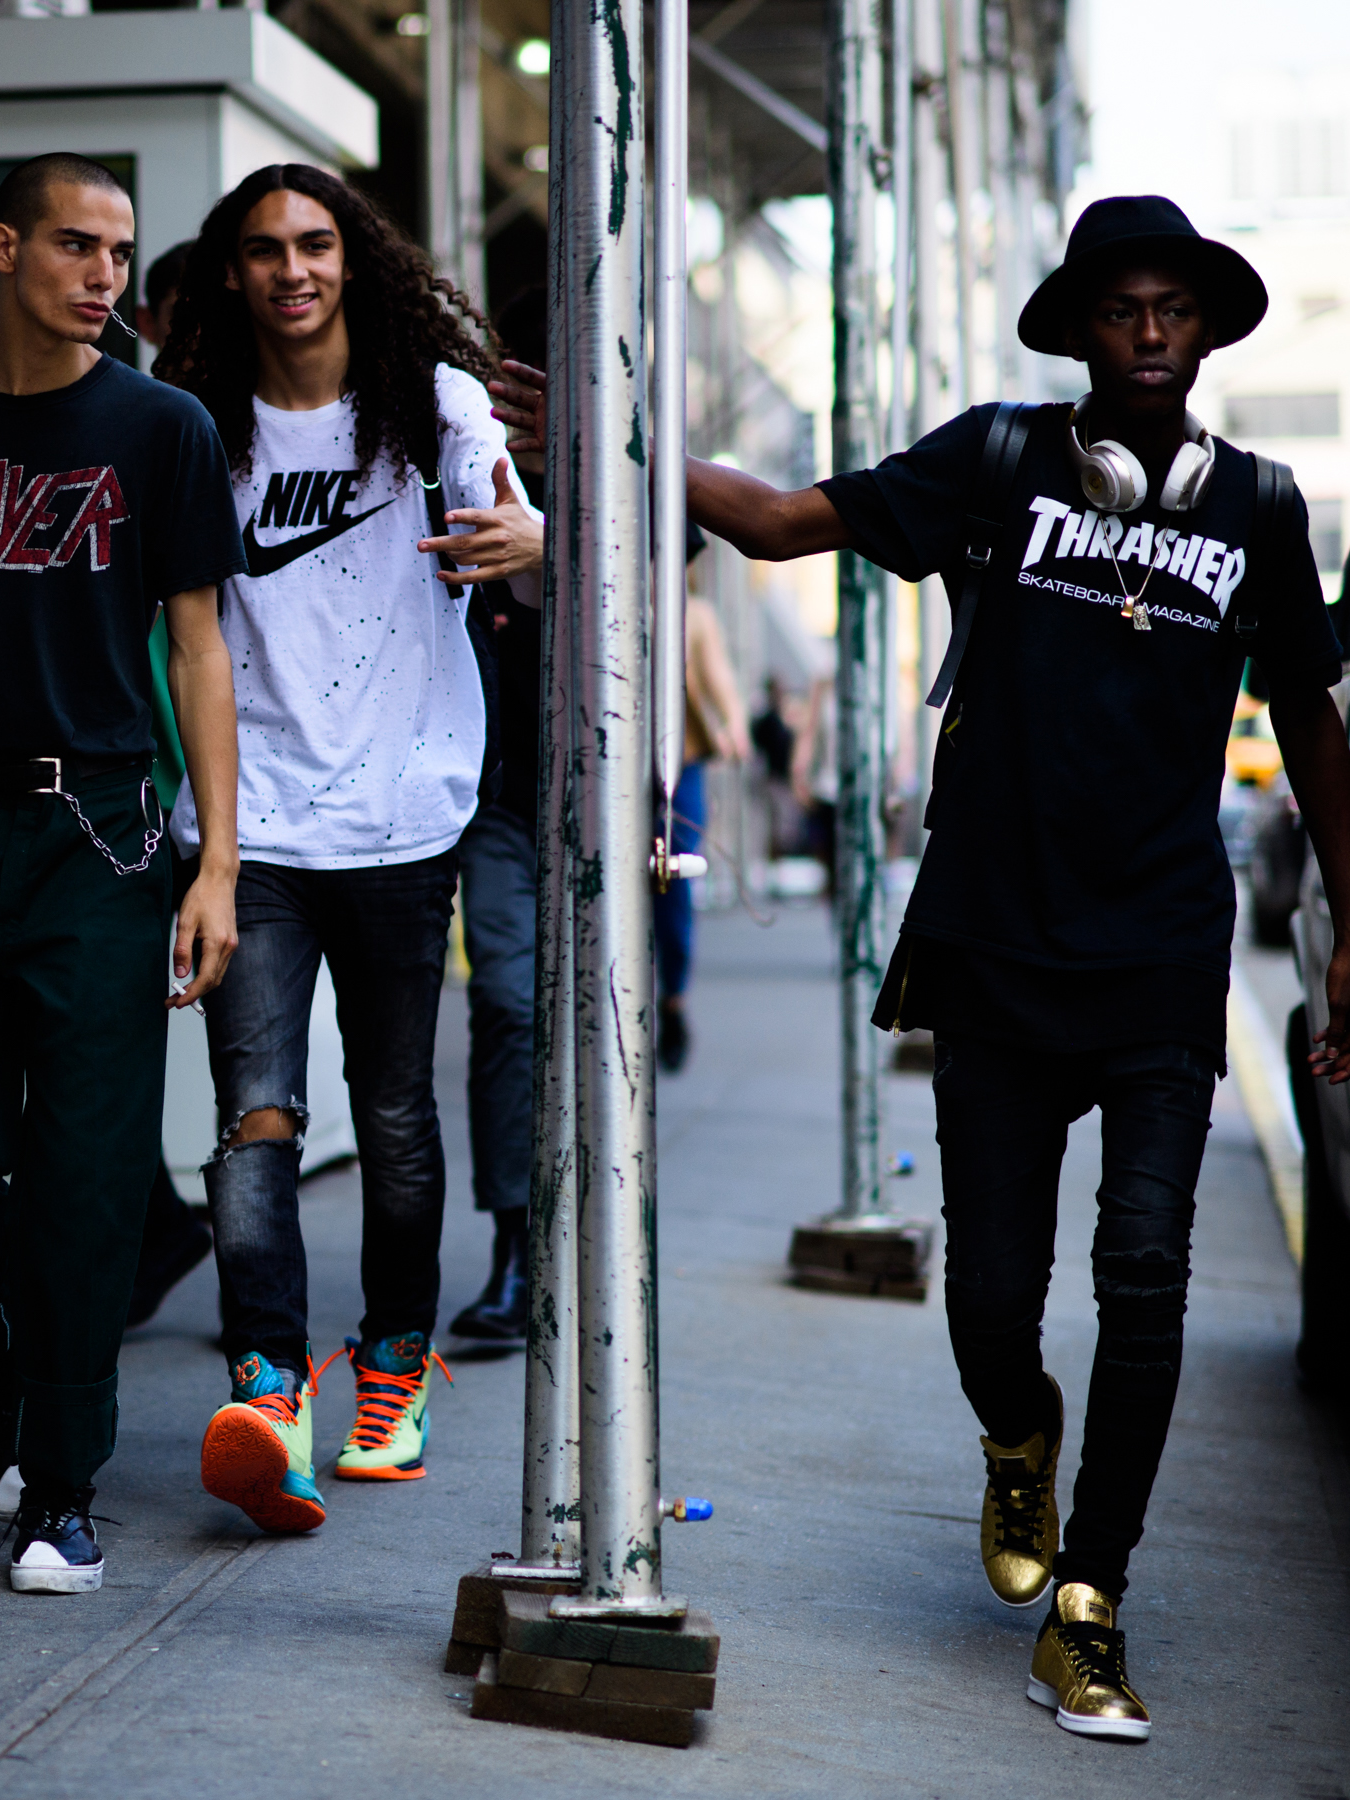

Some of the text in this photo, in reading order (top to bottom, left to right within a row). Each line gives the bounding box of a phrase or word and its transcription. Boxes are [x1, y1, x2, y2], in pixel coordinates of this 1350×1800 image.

[258, 469, 363, 529] NIKE
[1021, 495, 1246, 620] THRASHER
[1017, 571, 1221, 633] SKATEBOAR MAGAZINE
